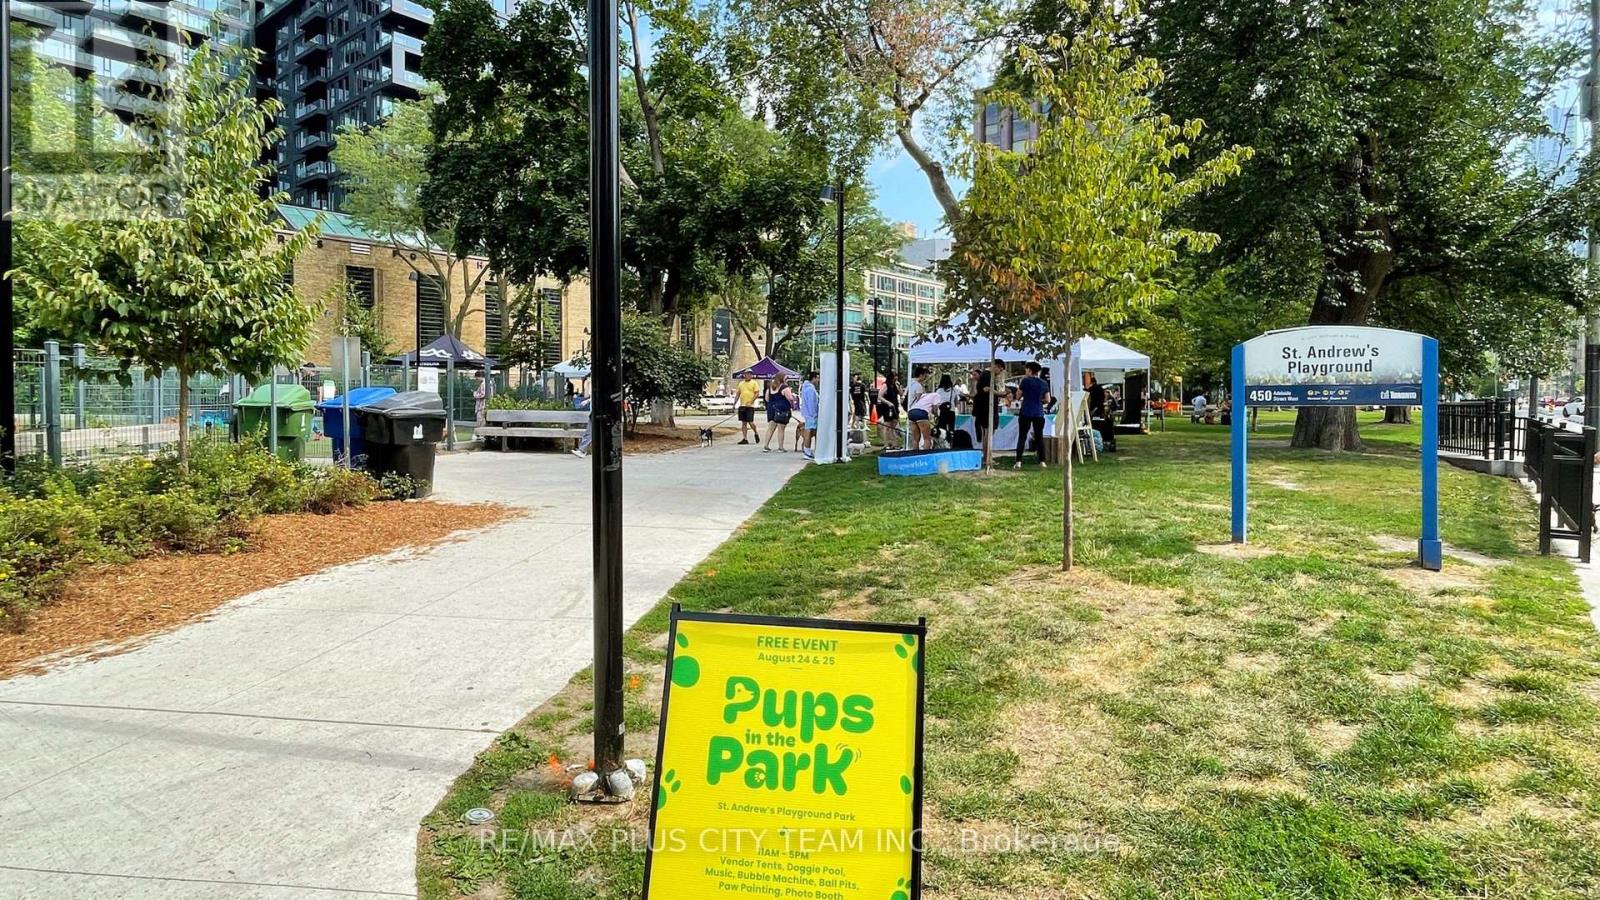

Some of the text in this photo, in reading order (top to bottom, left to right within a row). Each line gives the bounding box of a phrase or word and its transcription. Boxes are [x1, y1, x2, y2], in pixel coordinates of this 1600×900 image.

[1282, 344, 1379, 359] St. Andrew's
[1288, 359, 1373, 376] Playground
[1250, 390, 1272, 401] 450
[757, 635, 838, 652] FREE EVENT
[758, 652, 835, 665] August 24 & 25
[723, 675, 875, 743] Pups
[745, 729, 796, 747] in the
[706, 735, 854, 796] Park
[717, 802, 856, 822] St. Andrew's Playground Park
[789, 850, 810, 860] 5PM
[720, 856, 845, 877] Vendor Tents, Doggie Pool,
[705, 868, 735, 879] Music,
[737, 870, 771, 882] Bubble
[773, 874, 817, 887] Machine,
[819, 878, 837, 888] Ball
[719, 881, 844, 900] Paw Painting, Photo Booth
